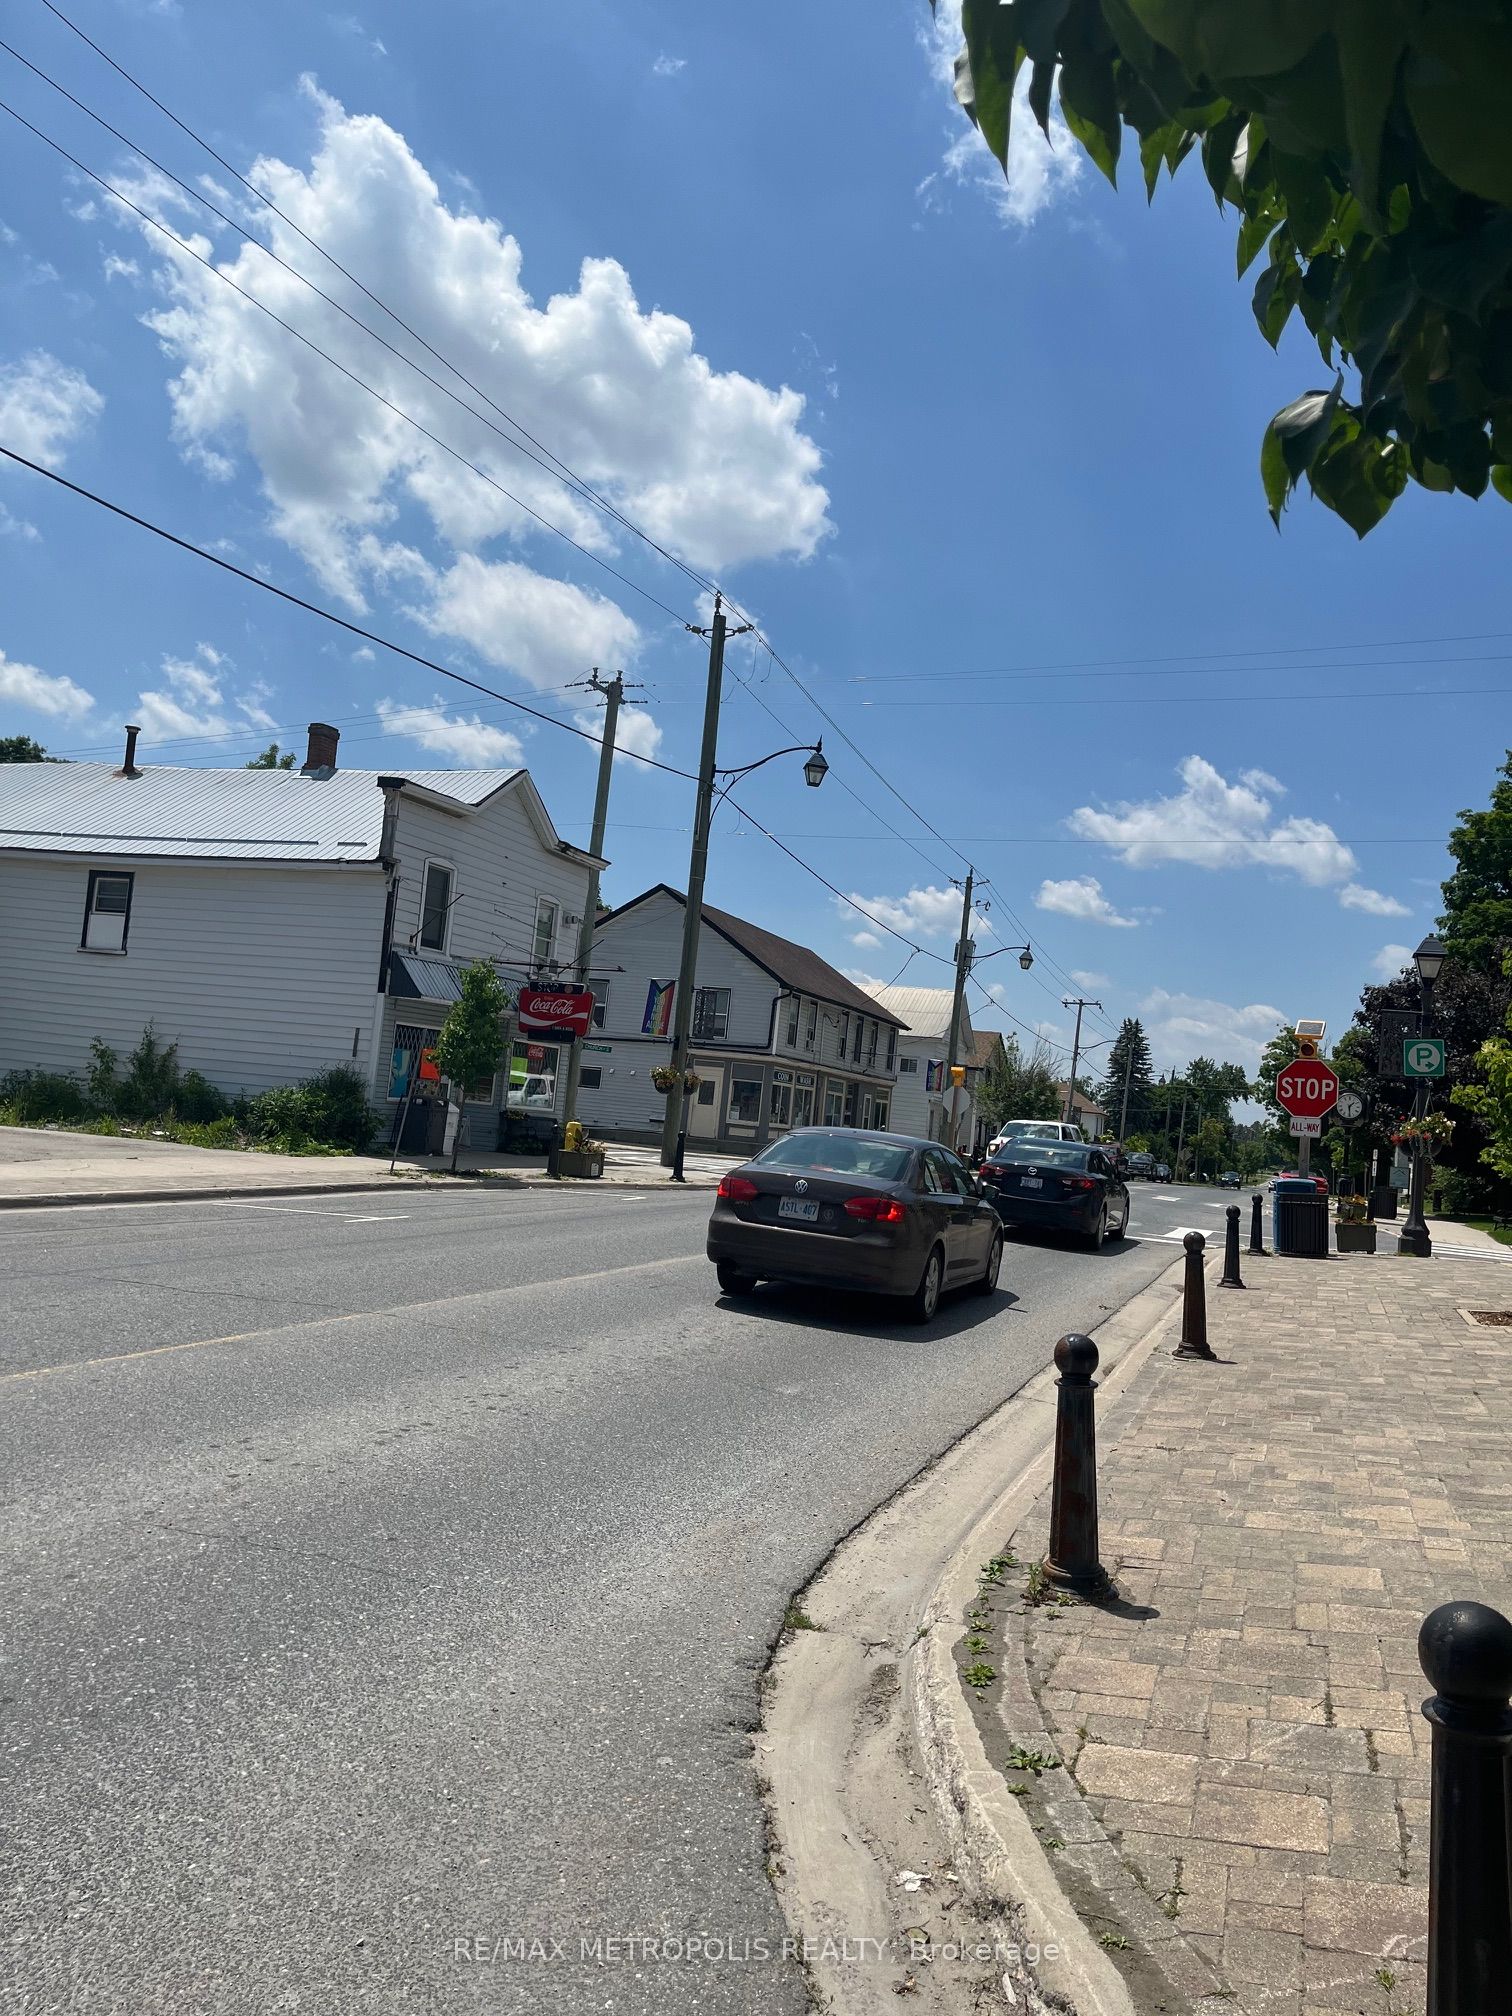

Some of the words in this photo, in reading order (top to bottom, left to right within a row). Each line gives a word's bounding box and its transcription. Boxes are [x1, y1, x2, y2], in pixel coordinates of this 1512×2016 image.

[1416, 1047, 1433, 1066] P
[1280, 1077, 1335, 1100] STOP
[1290, 1121, 1320, 1133] ALL-WAY
